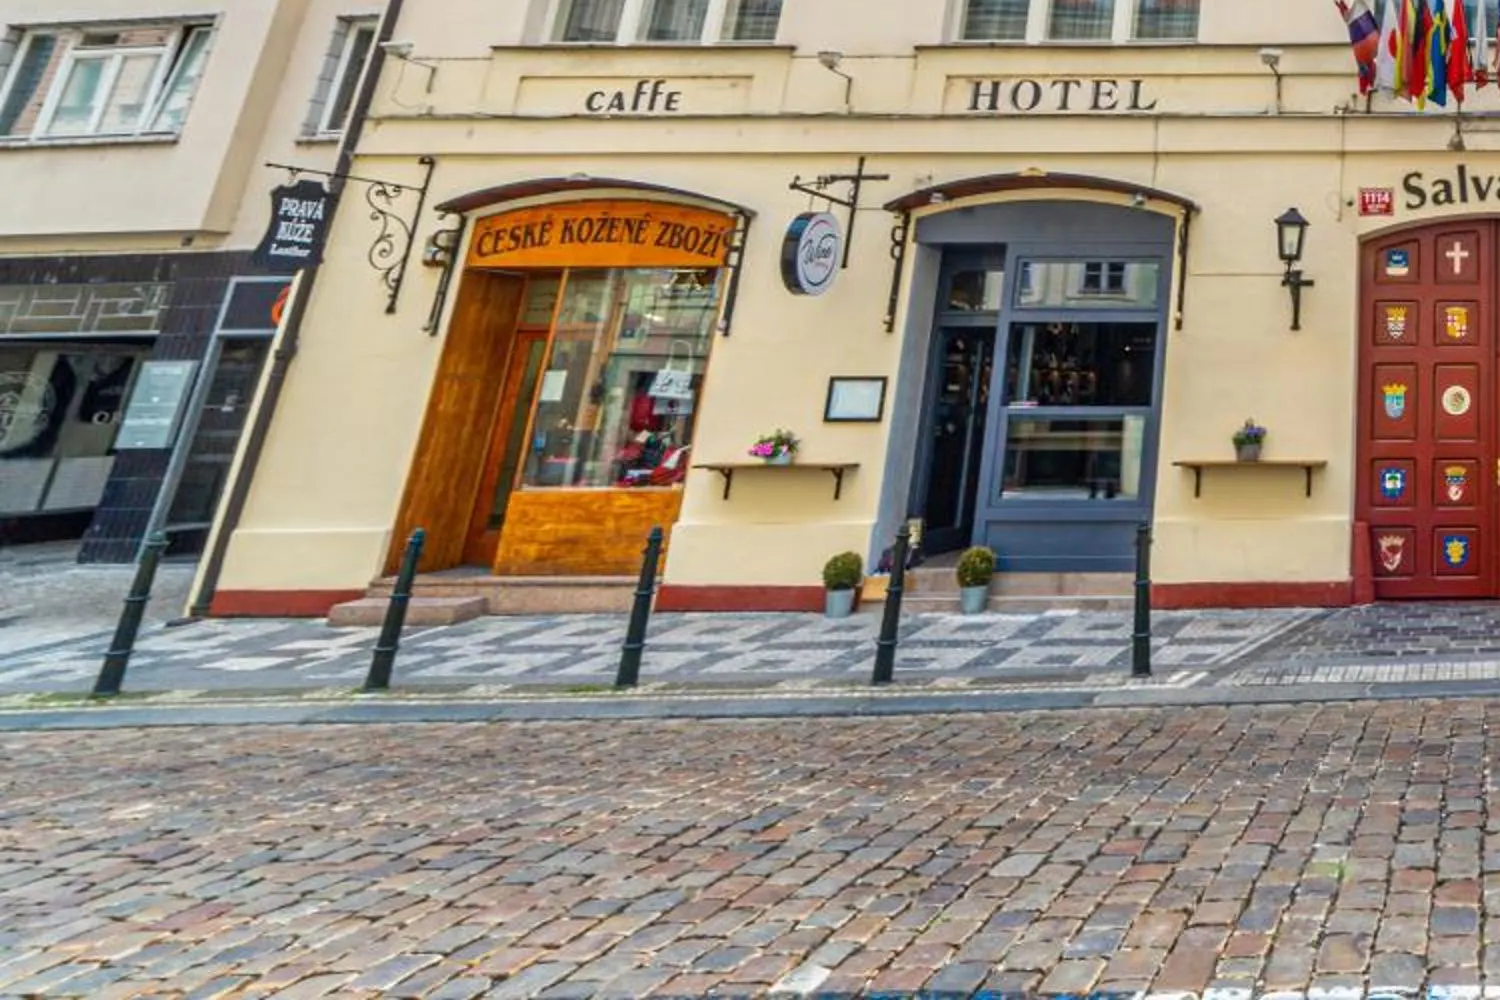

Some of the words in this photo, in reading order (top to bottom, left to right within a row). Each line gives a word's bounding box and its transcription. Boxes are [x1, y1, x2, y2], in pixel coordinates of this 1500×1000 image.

[967, 79, 1158, 111] HOTEL
[278, 197, 326, 220] PRAVÁ
[476, 214, 554, 258] ČESKÉ
[559, 212, 653, 246] KOŽENÉ
[653, 220, 726, 259] ZBOŽÍ
